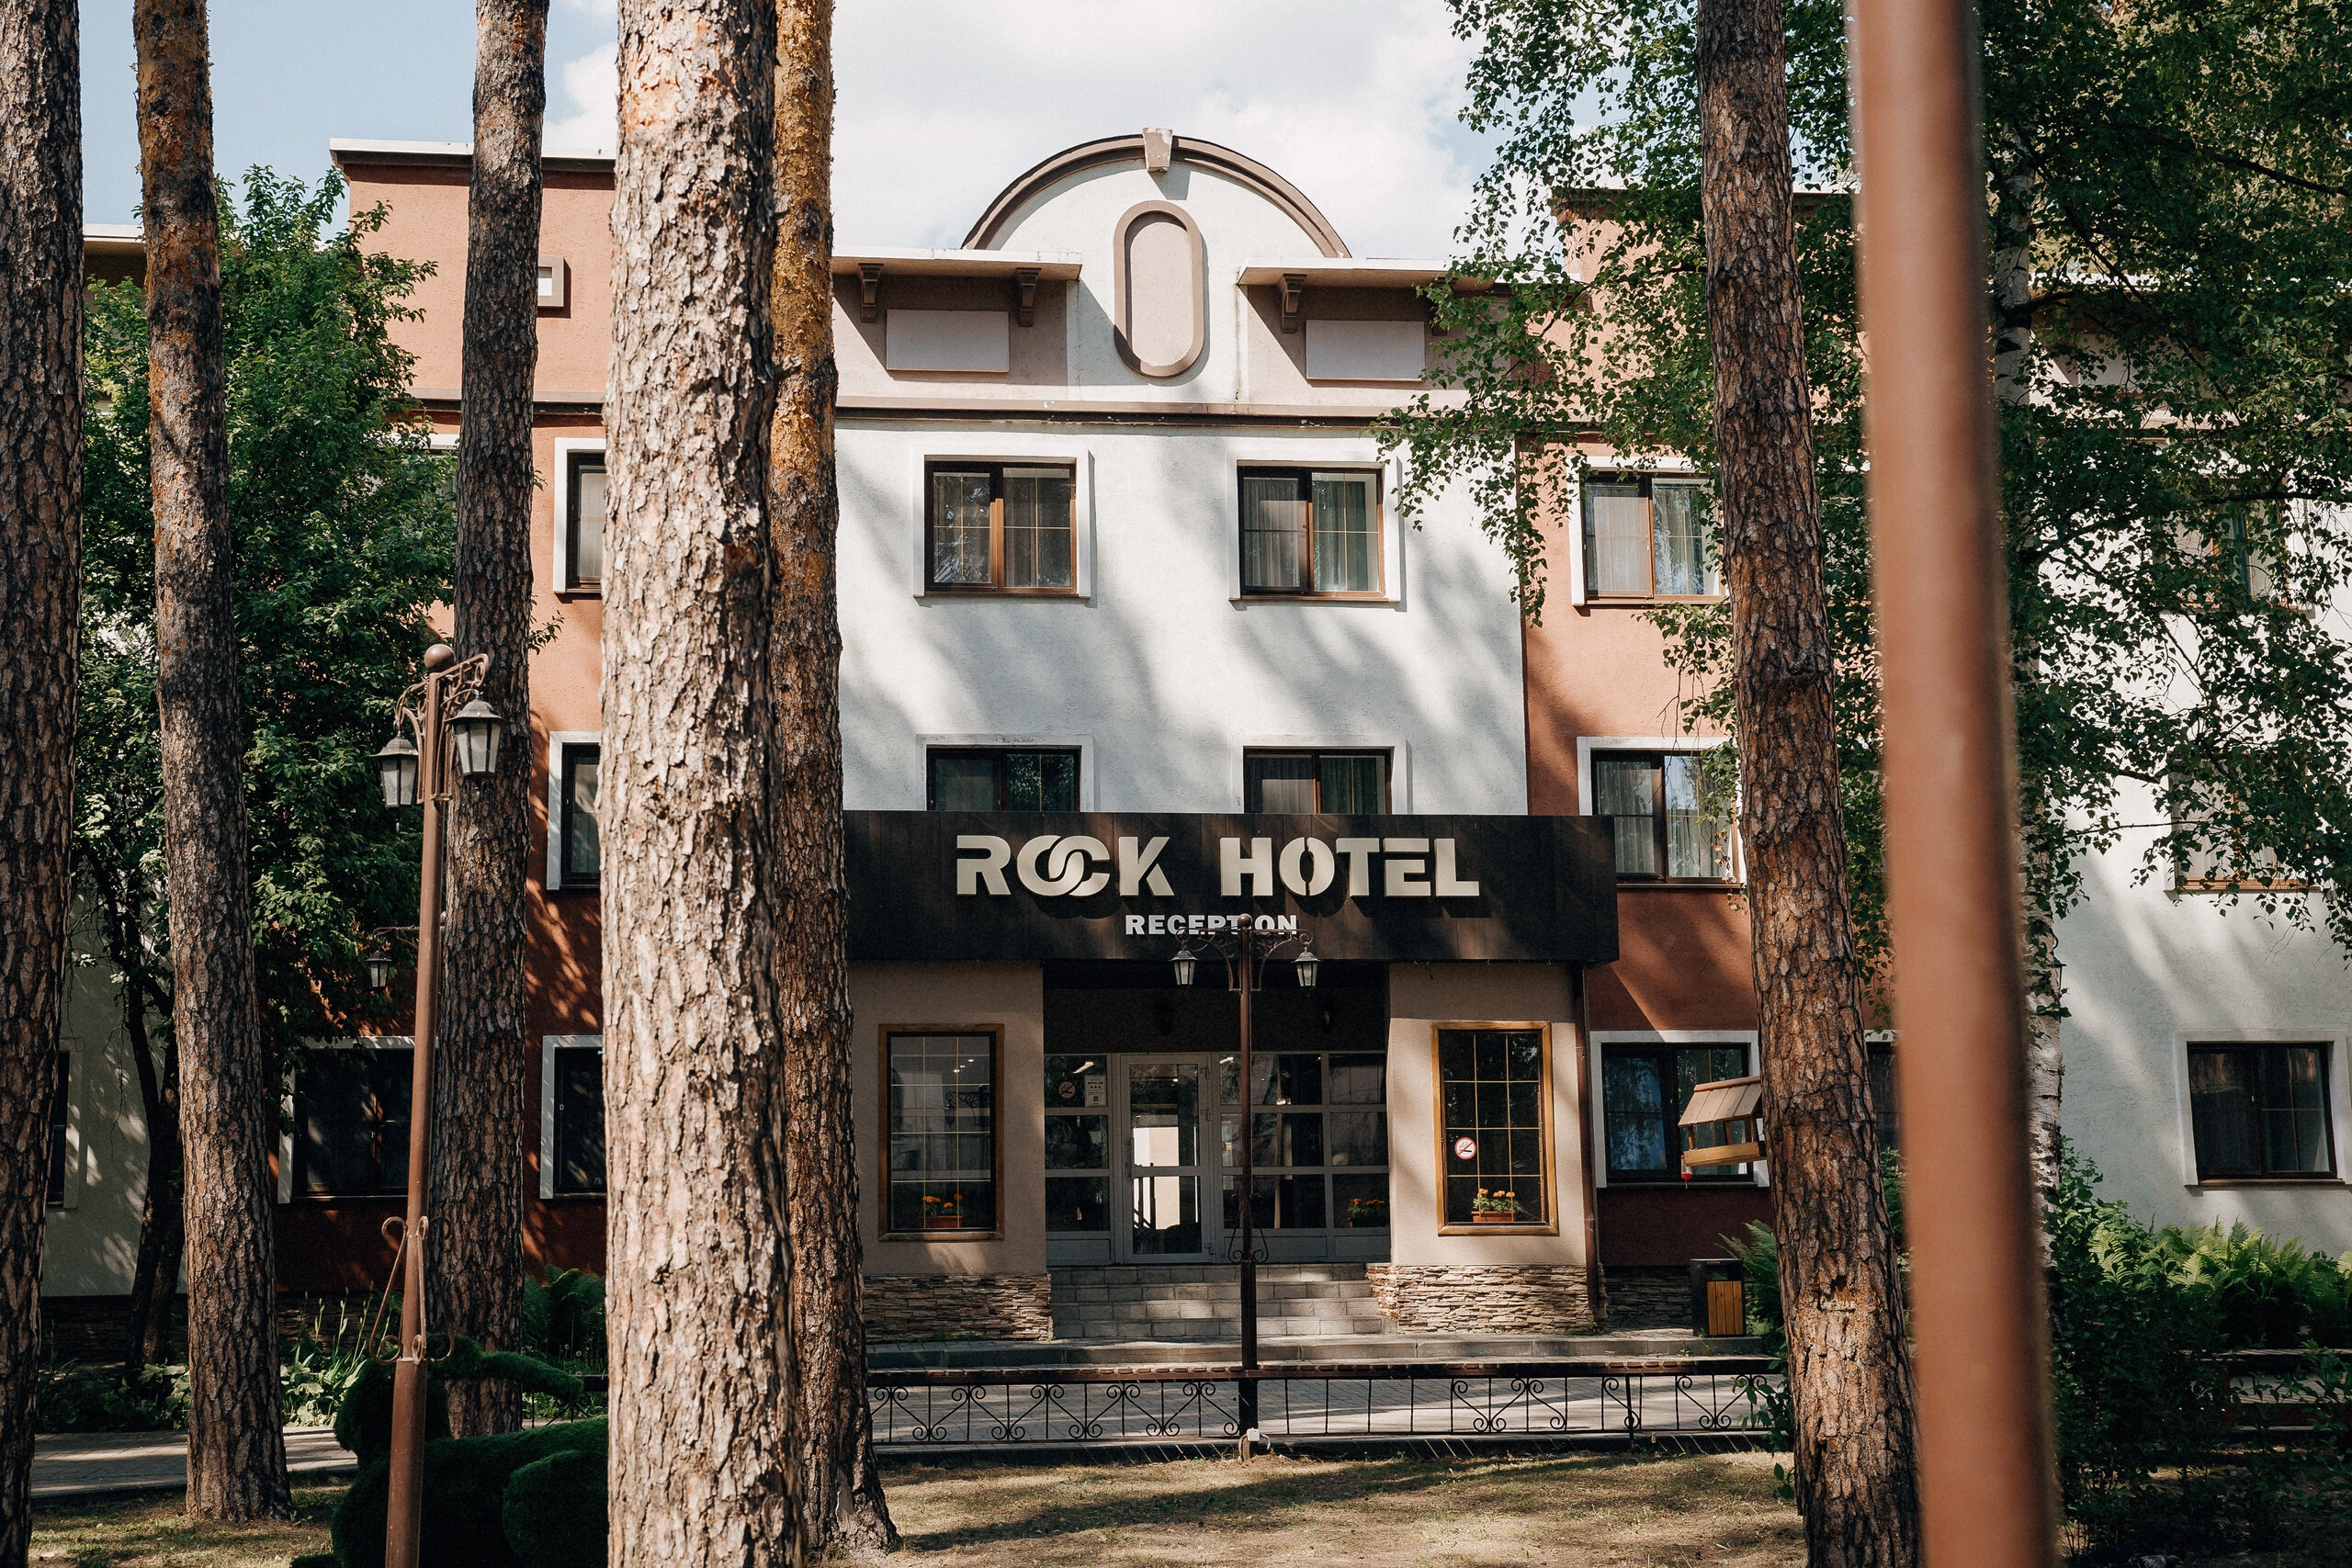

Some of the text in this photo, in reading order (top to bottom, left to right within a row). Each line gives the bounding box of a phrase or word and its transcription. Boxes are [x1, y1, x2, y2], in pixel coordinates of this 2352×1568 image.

[956, 834, 1480, 897] ROCK HOTEL
[1125, 914, 1297, 935] RECEPTON
